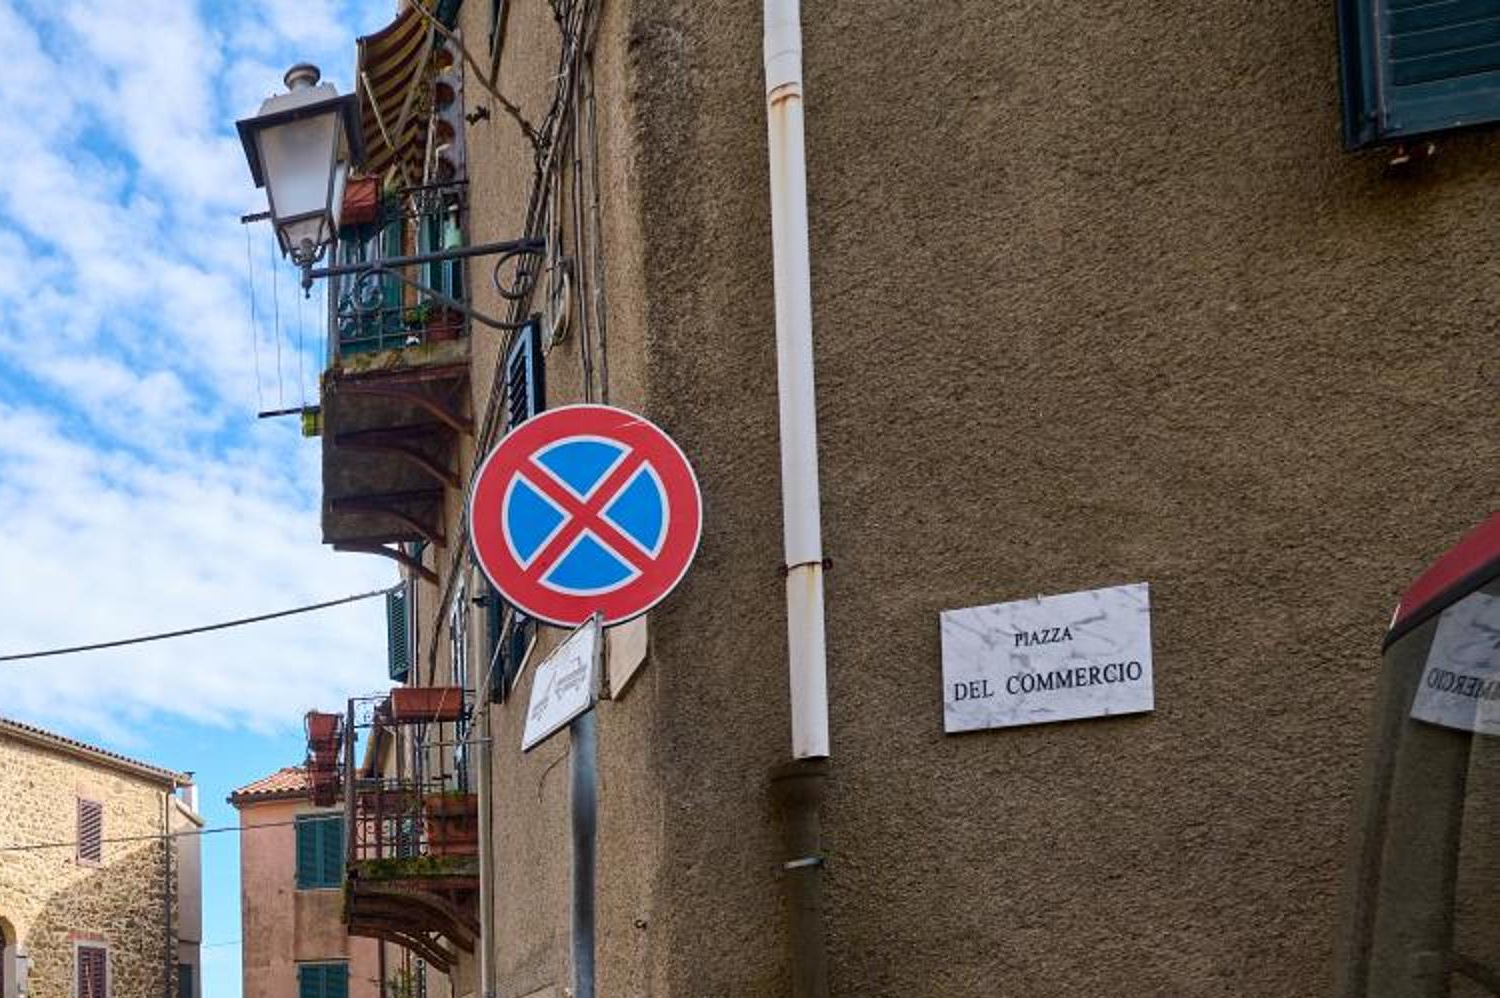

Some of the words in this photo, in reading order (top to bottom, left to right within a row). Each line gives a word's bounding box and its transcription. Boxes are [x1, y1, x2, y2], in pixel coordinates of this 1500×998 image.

[1014, 626, 1073, 647] PIAZZA
[954, 678, 994, 701] DEL
[1006, 660, 1142, 695] COMMERCIO
